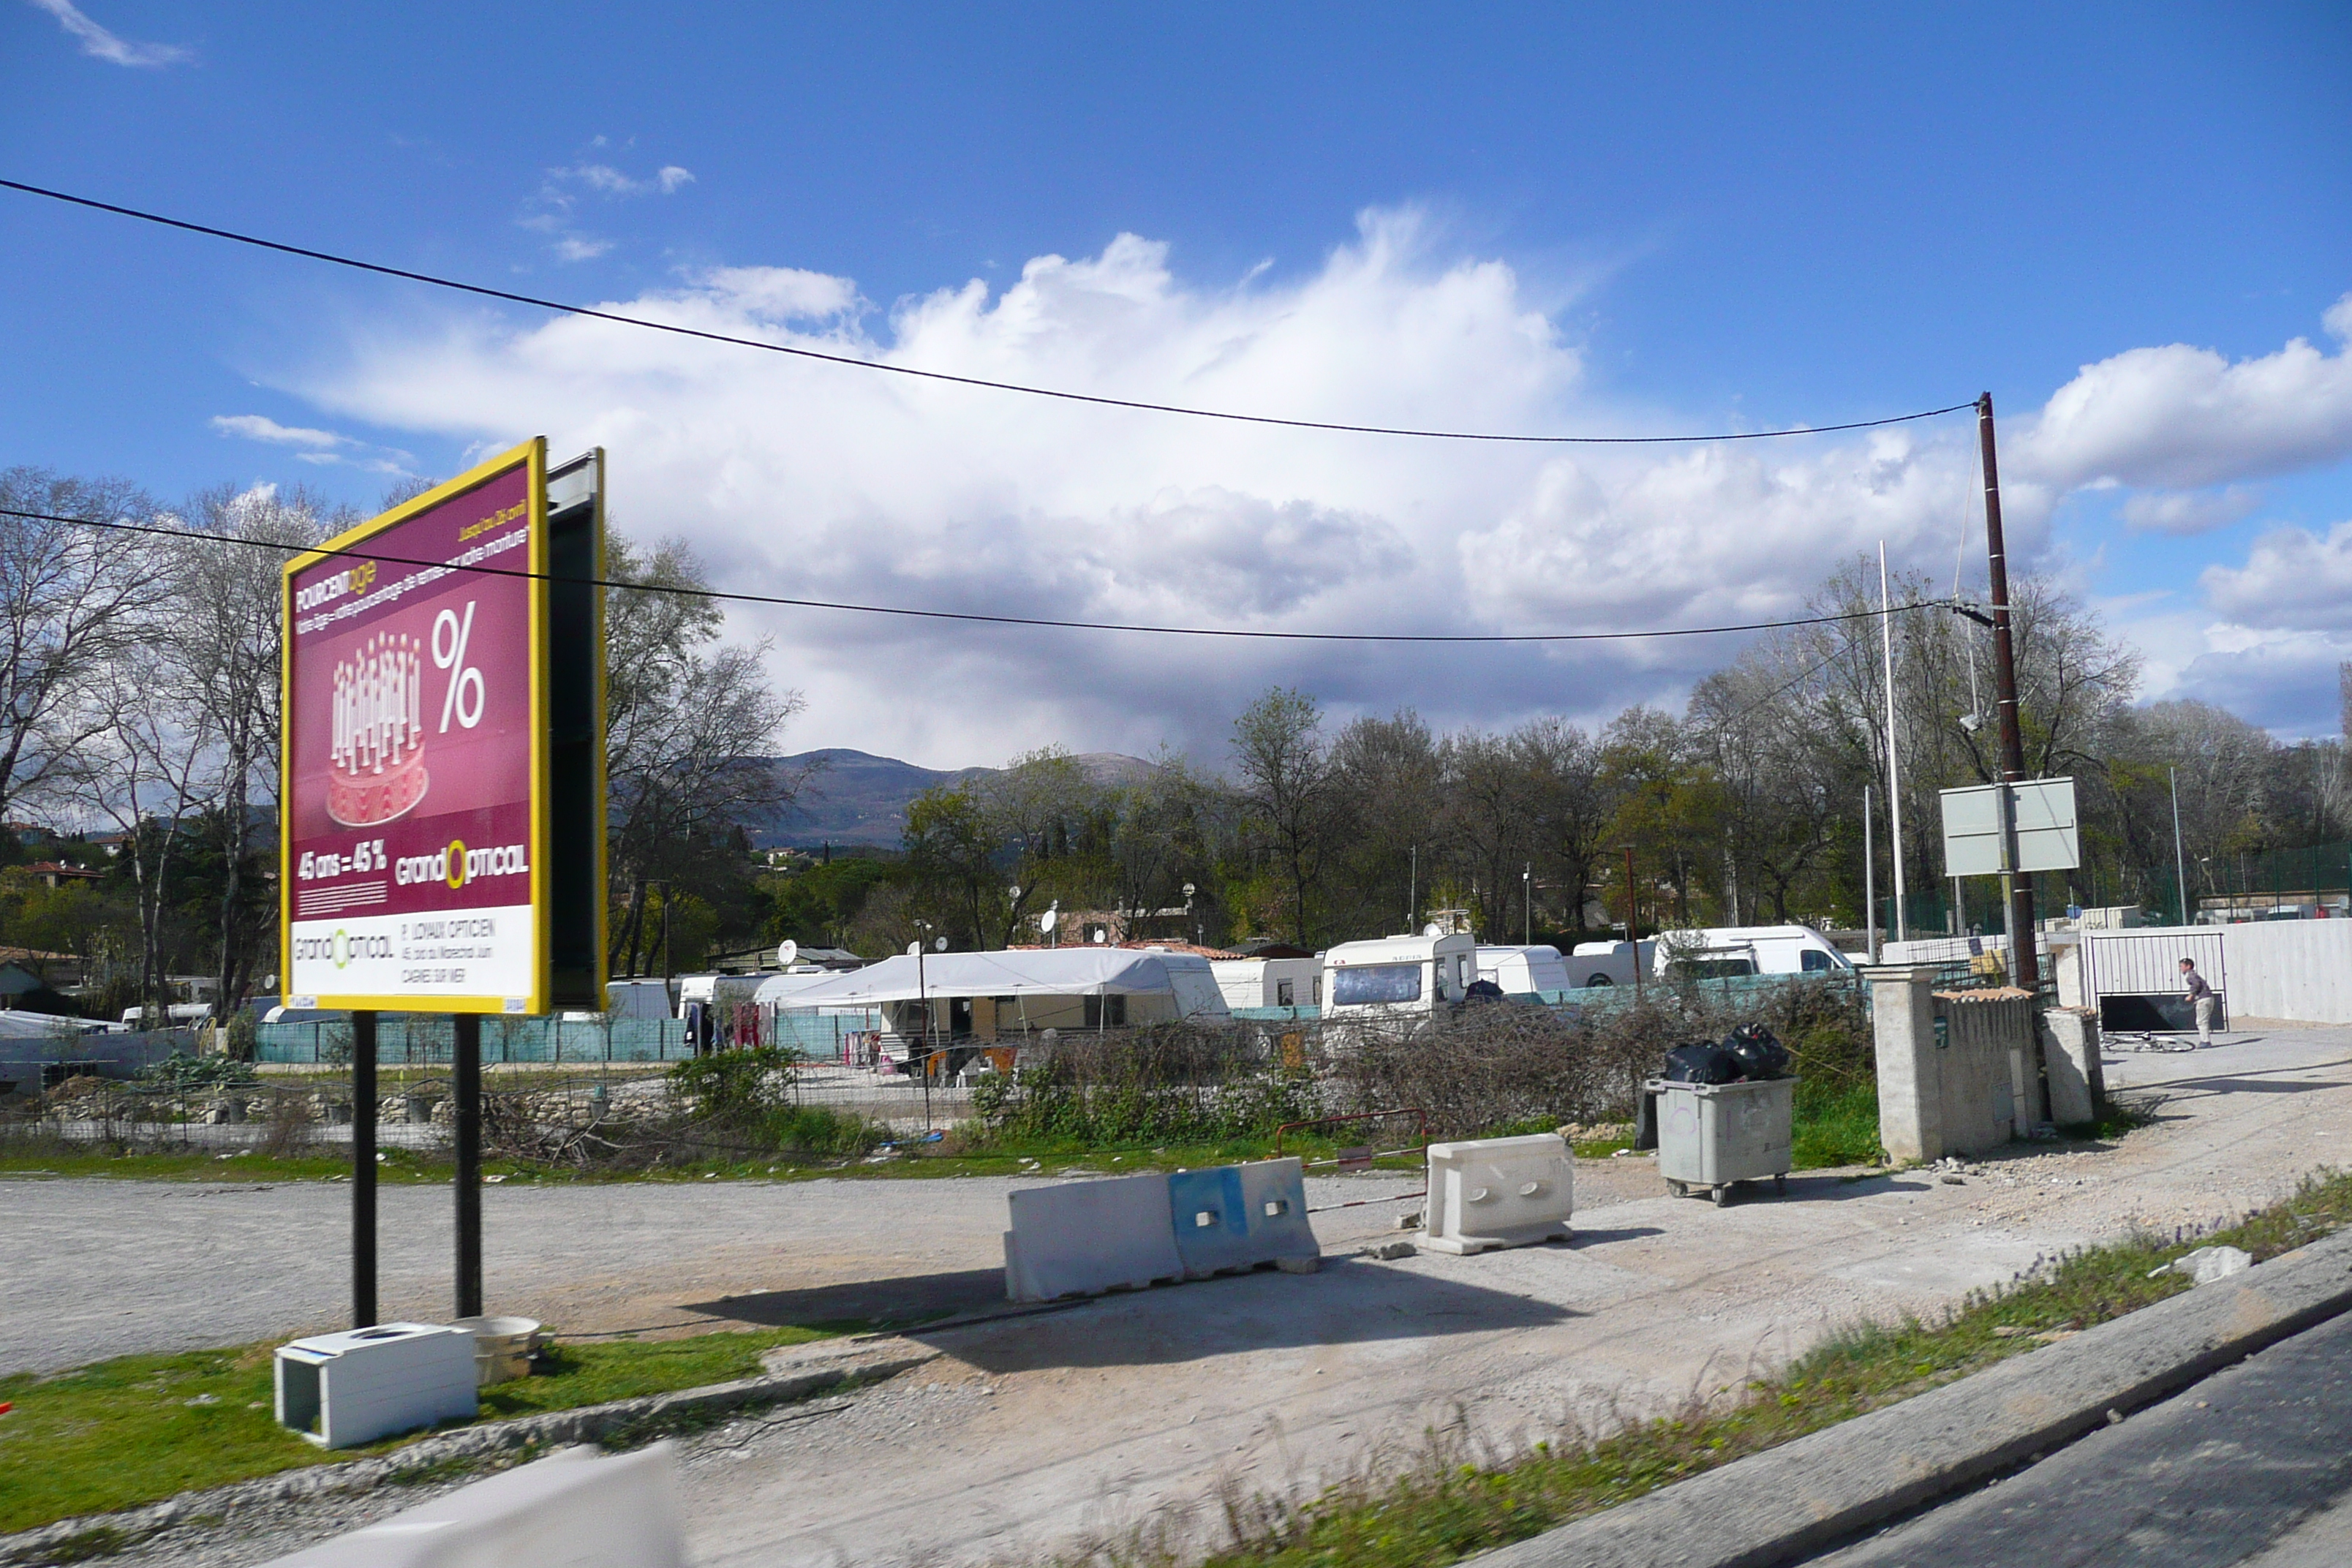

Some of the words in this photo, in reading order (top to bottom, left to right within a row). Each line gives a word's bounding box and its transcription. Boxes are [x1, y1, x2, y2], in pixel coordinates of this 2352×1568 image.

[295, 560, 377, 613] POURCENTage
[298, 851, 315, 881] 45
[315, 853, 340, 878] ans
[340, 856, 353, 872] =
[448, 919, 497, 938] OPTICIEN
